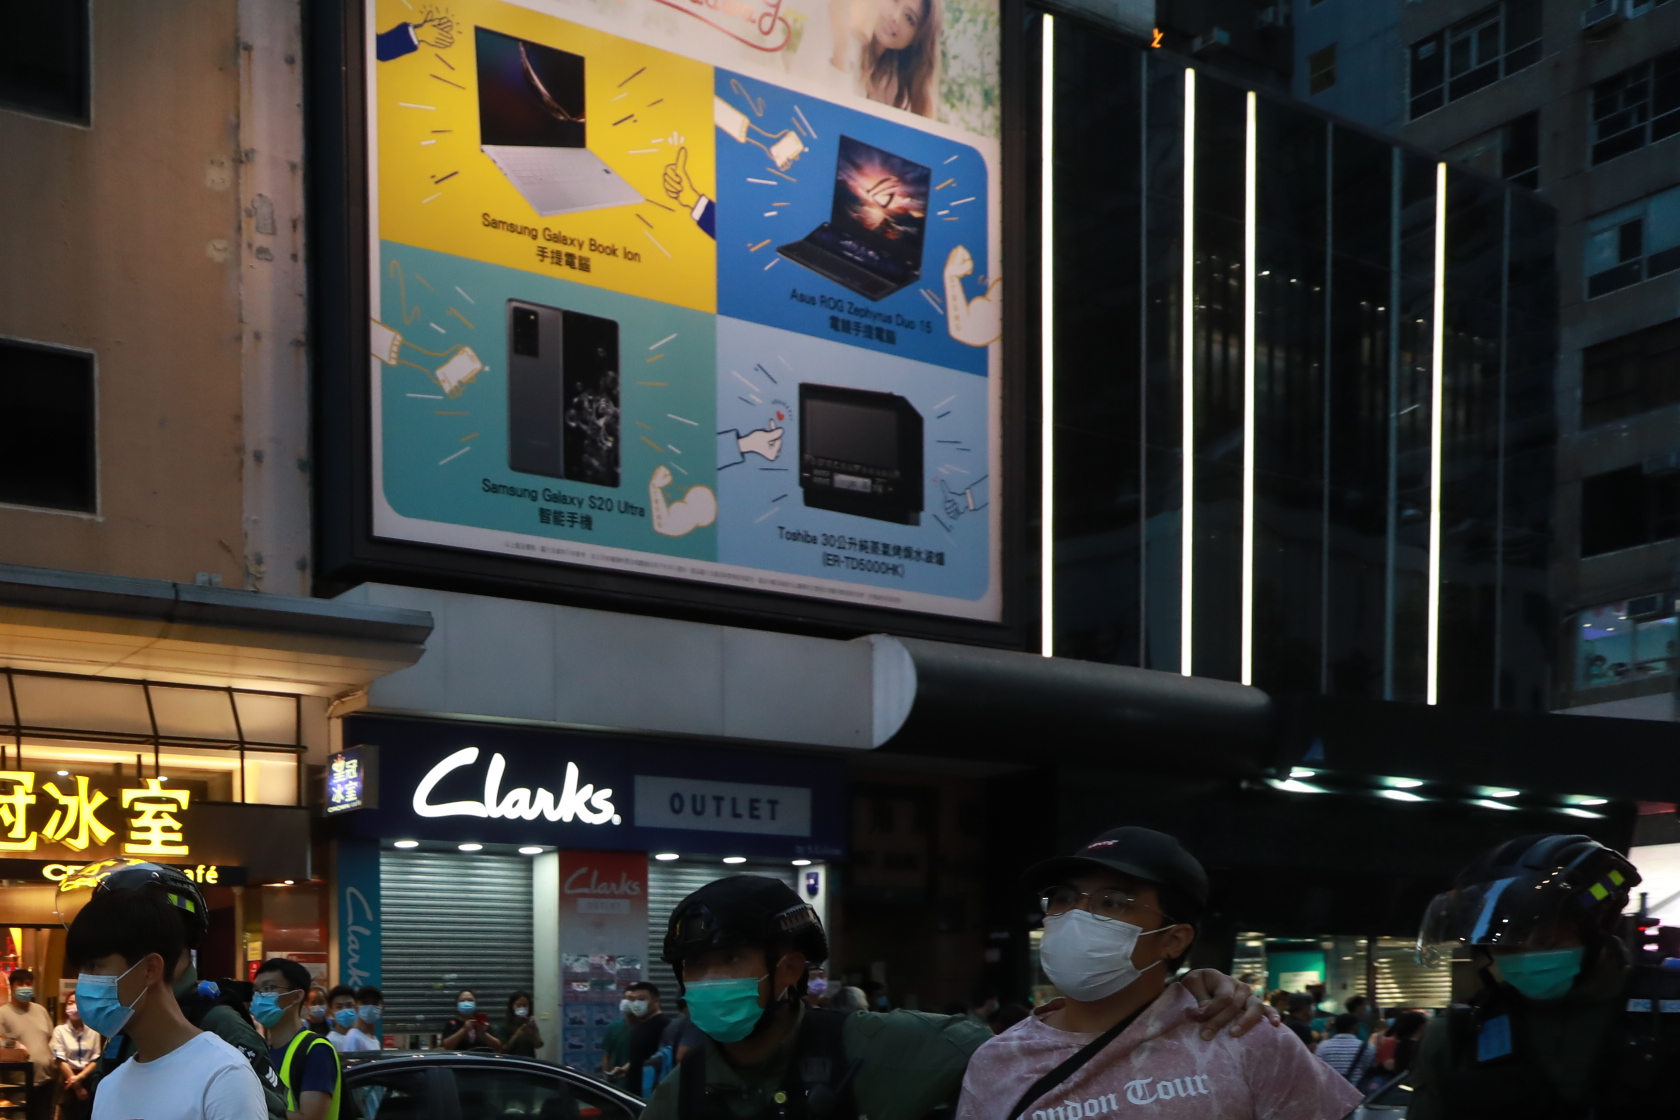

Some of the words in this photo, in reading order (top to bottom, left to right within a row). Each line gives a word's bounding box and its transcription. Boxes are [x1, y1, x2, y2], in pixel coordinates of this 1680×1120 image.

[482, 213, 538, 240] Samsung
[543, 227, 584, 251] Galaxy
[589, 238, 619, 258] Book
[623, 247, 641, 263] Ion
[537, 246, 591, 273] 手提電腦
[790, 288, 817, 306] Asus
[820, 295, 844, 313] ROG
[847, 301, 894, 325] Zephyrus
[896, 313, 916, 330] Duo
[921, 320, 933, 334] 15
[482, 478, 538, 501] Samsung
[543, 488, 584, 508] Galaxy
[589, 495, 614, 511] S20
[618, 499, 646, 517] Ultra
[538, 507, 593, 530] 智能手機
[777, 526, 818, 545] Toshiba
[412, 746, 614, 826] Clarks
[669, 792, 779, 821] OUTLET
[565, 867, 642, 895] Clarks
[345, 886, 375, 988] Clark
[1123, 1073, 1211, 1106] Tour
